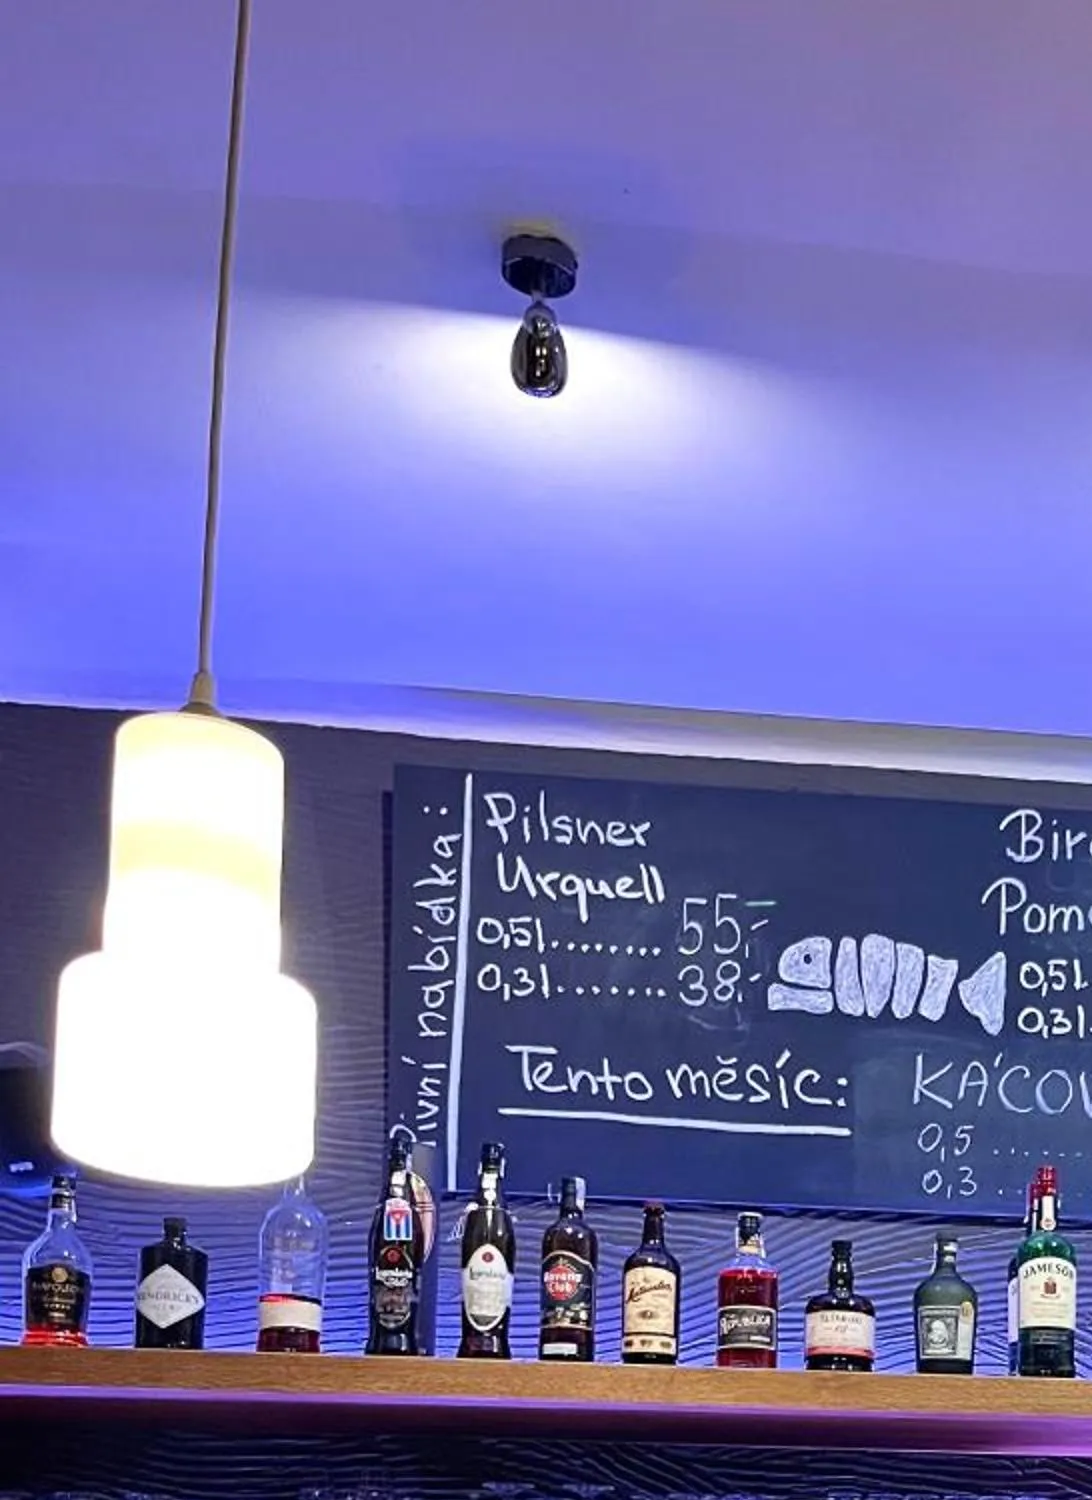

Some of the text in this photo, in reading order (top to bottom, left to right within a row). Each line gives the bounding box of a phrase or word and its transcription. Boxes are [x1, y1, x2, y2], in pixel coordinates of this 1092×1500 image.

[483, 789, 651, 848] Pilsner
[498, 853, 664, 923] Urquell
[504, 1045, 849, 1109] Tento měsíc:
[917, 1123, 974, 1161] 0,5
[921, 1168, 977, 1198] 0,3
